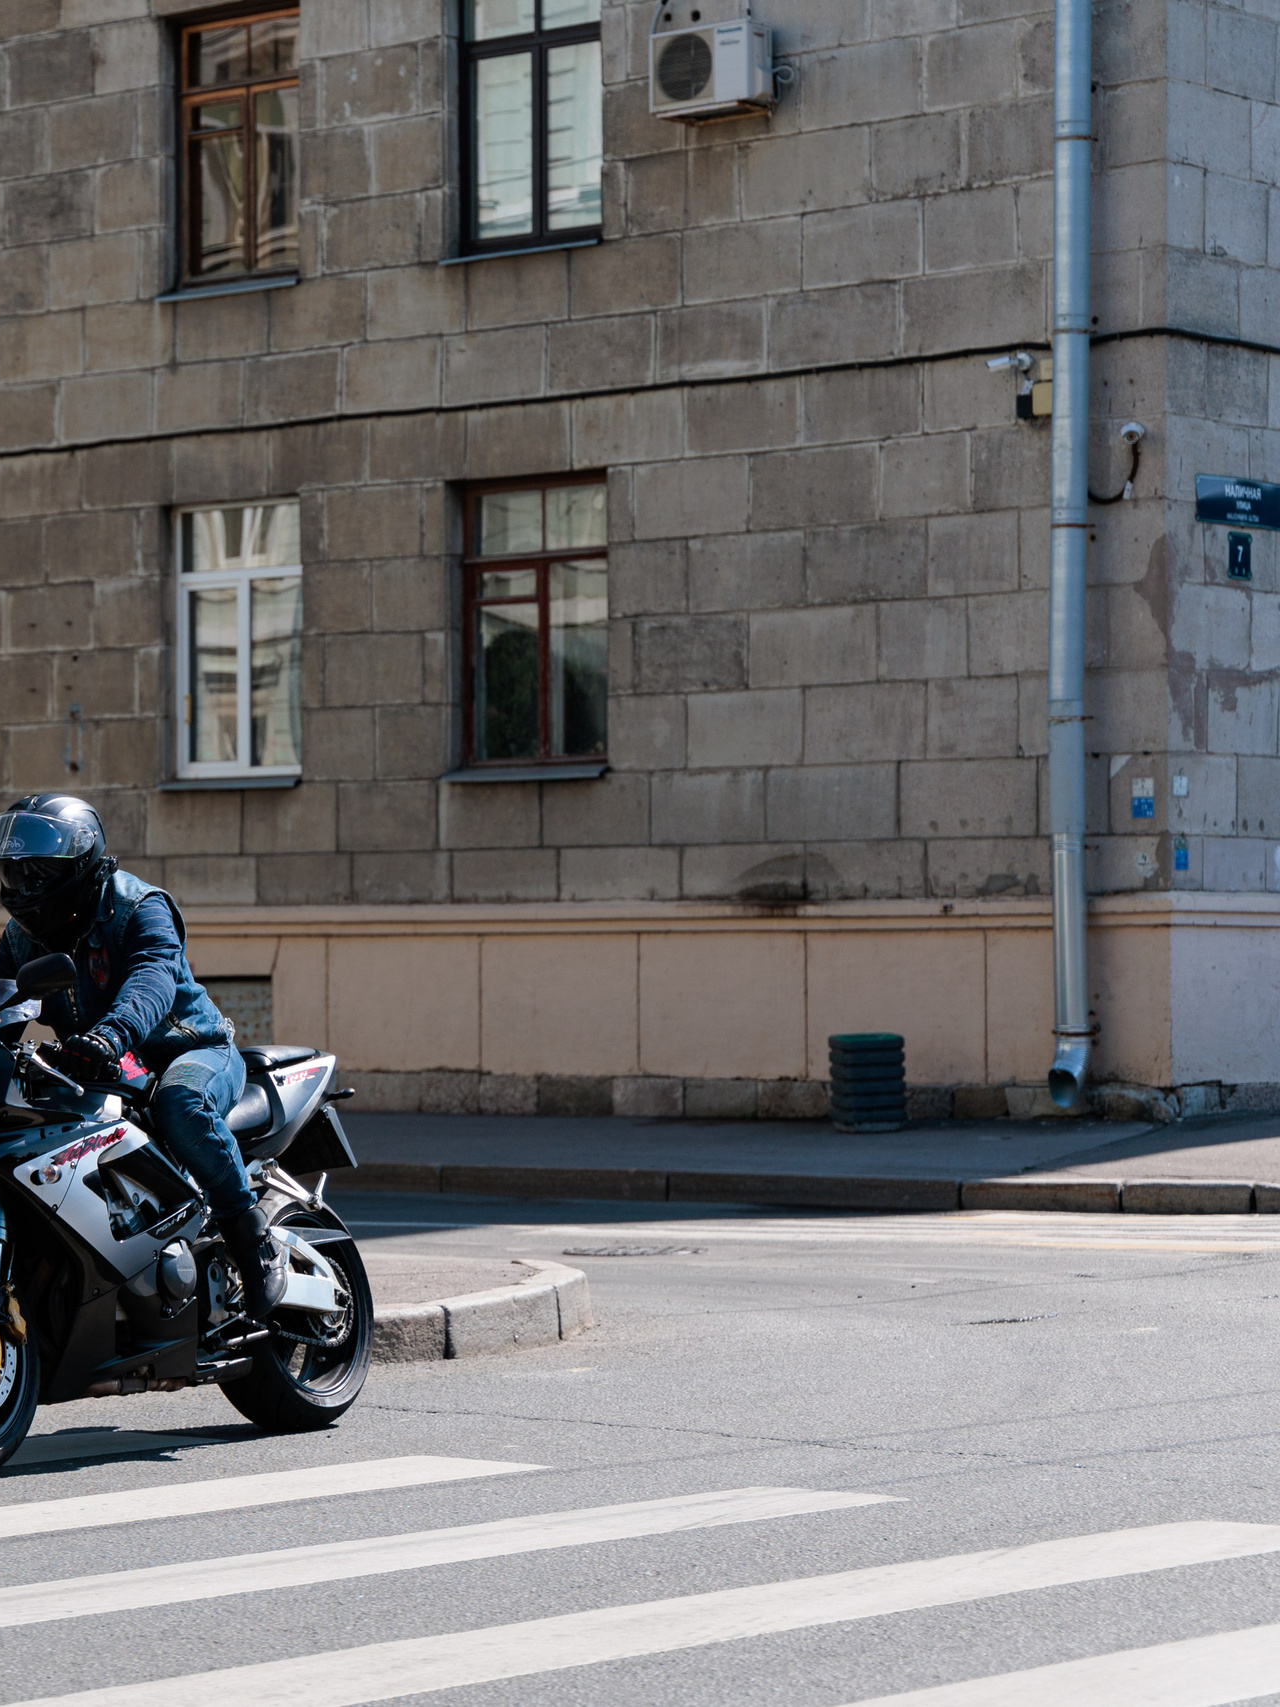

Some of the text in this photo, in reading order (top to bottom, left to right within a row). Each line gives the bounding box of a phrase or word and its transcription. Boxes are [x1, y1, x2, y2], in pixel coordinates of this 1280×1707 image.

[1224, 484, 1262, 501] НАЛИЧНАЯ
[1237, 545, 1244, 563] 7
[155, 1210, 187, 1236] PGM-FI
